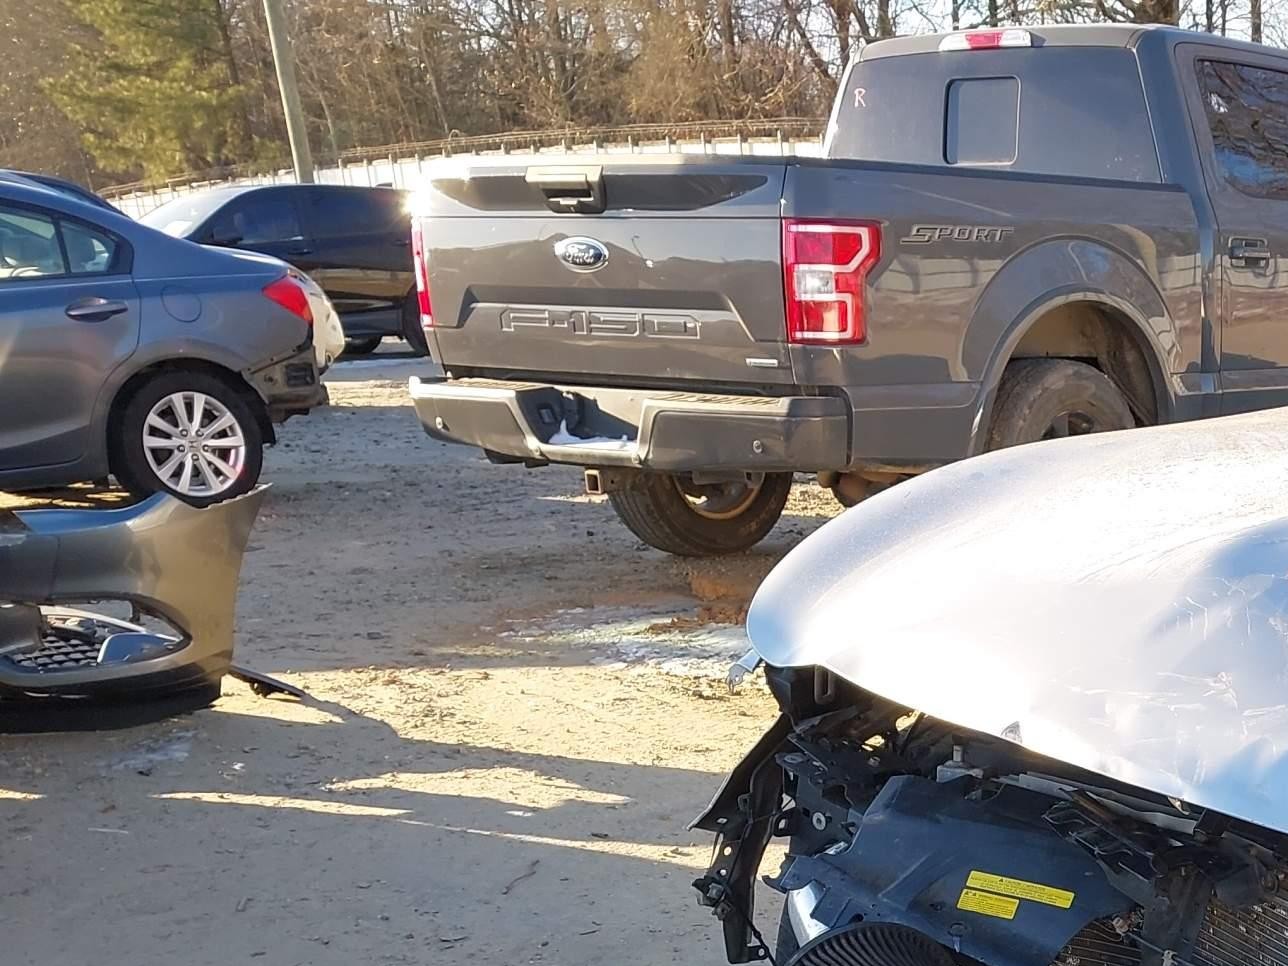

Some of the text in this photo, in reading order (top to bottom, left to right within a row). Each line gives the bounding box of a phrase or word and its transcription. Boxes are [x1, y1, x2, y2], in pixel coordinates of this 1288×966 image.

[854, 87, 866, 108] R
[900, 224, 1015, 245] SPORT
[500, 308, 701, 340] F-150
